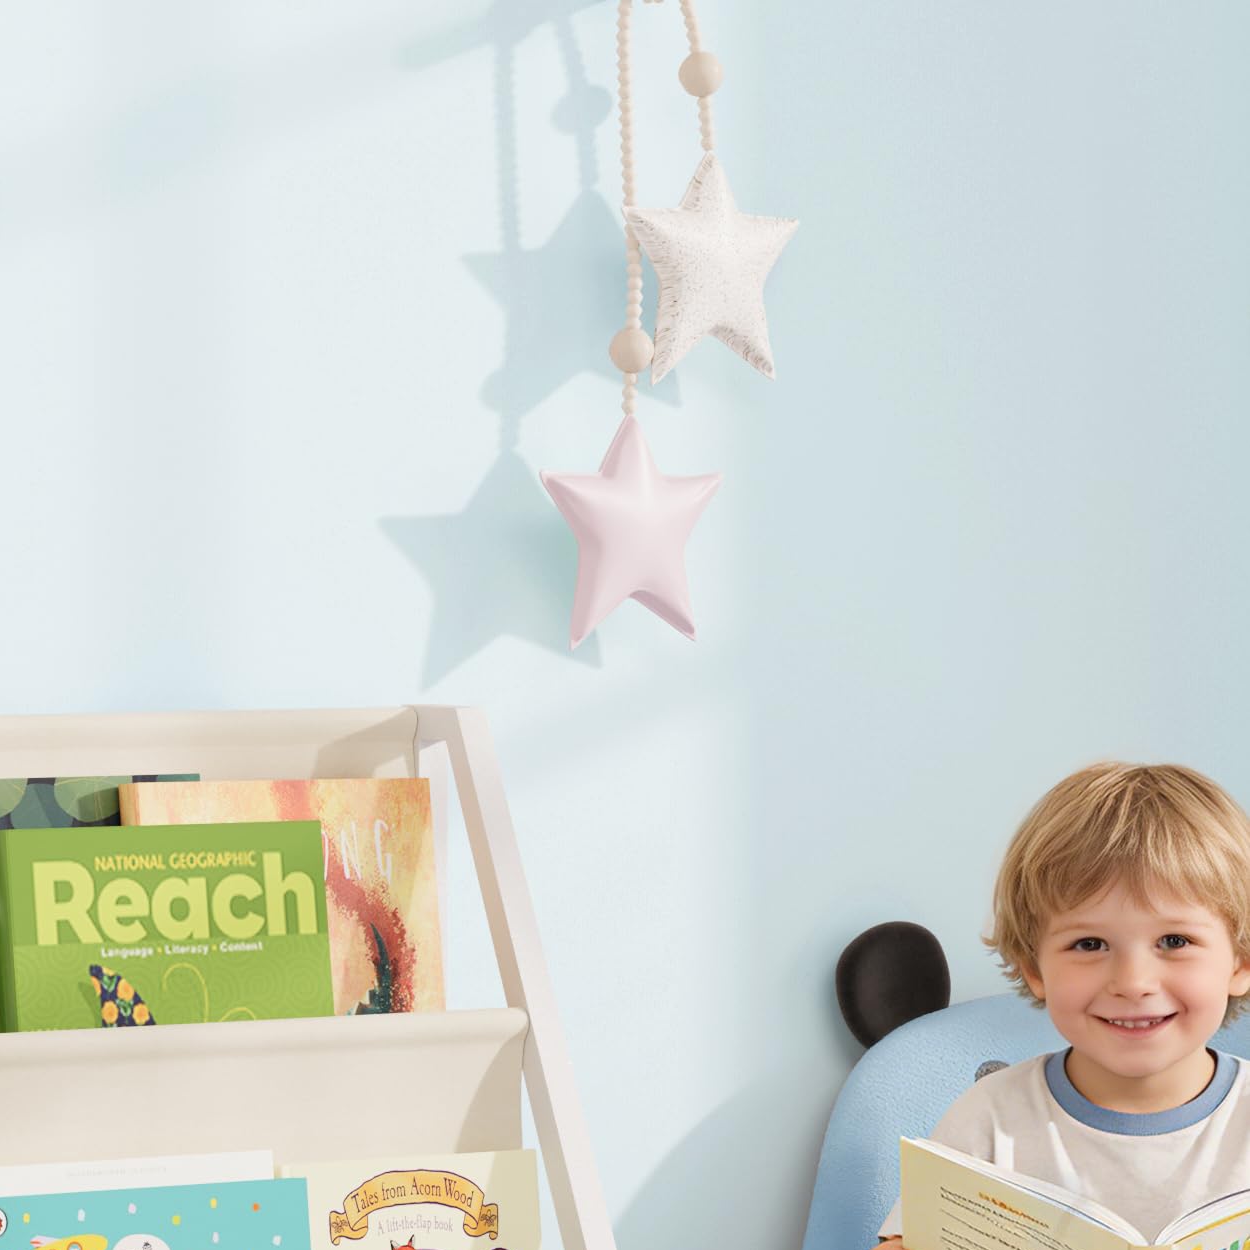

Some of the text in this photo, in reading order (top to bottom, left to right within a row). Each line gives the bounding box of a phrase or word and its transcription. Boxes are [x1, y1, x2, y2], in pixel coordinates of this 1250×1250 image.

[94, 851, 257, 872] NATIONAL GEOGRAPHIC
[32, 851, 318, 946] Reach
[101, 941, 263, 959] Language Literacy Content
[351, 1176, 474, 1213] Tales from Acorn Wood
[377, 1220, 385, 1235] A
[434, 1216, 454, 1232] book
